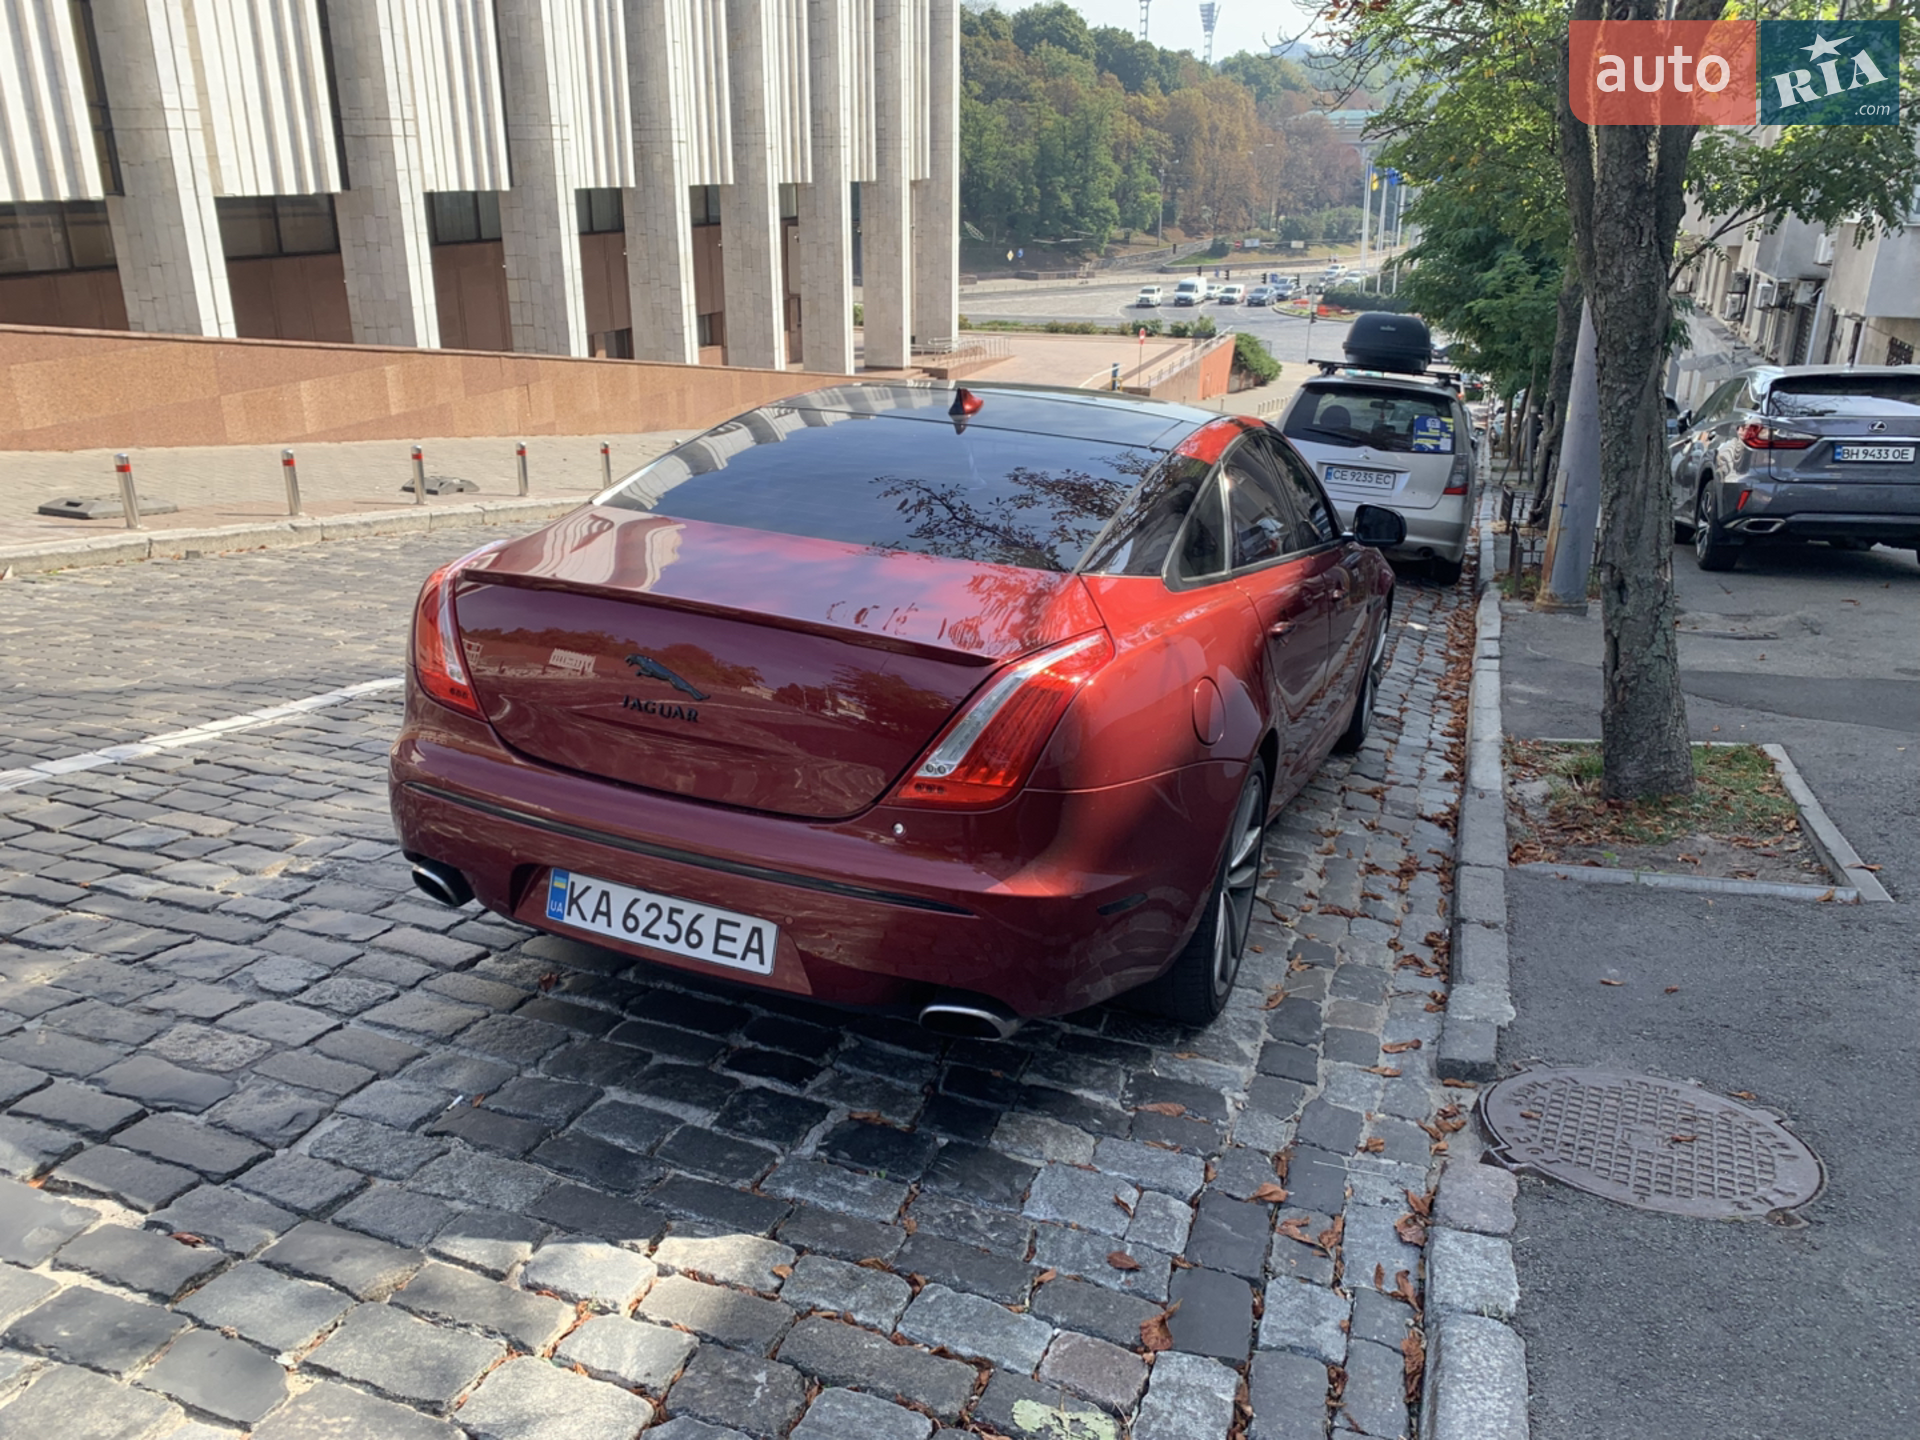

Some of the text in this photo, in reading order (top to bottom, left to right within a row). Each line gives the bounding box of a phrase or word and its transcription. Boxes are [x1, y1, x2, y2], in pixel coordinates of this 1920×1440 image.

[1842, 448, 1860, 460] BH
[1862, 448, 1890, 460] 9433
[1892, 448, 1910, 460] OE
[1333, 470, 1391, 485] CE 9235 EC
[622, 695, 699, 723] JAGUAR
[550, 900, 564, 914] UA
[566, 881, 765, 966] KA 6256 EA
